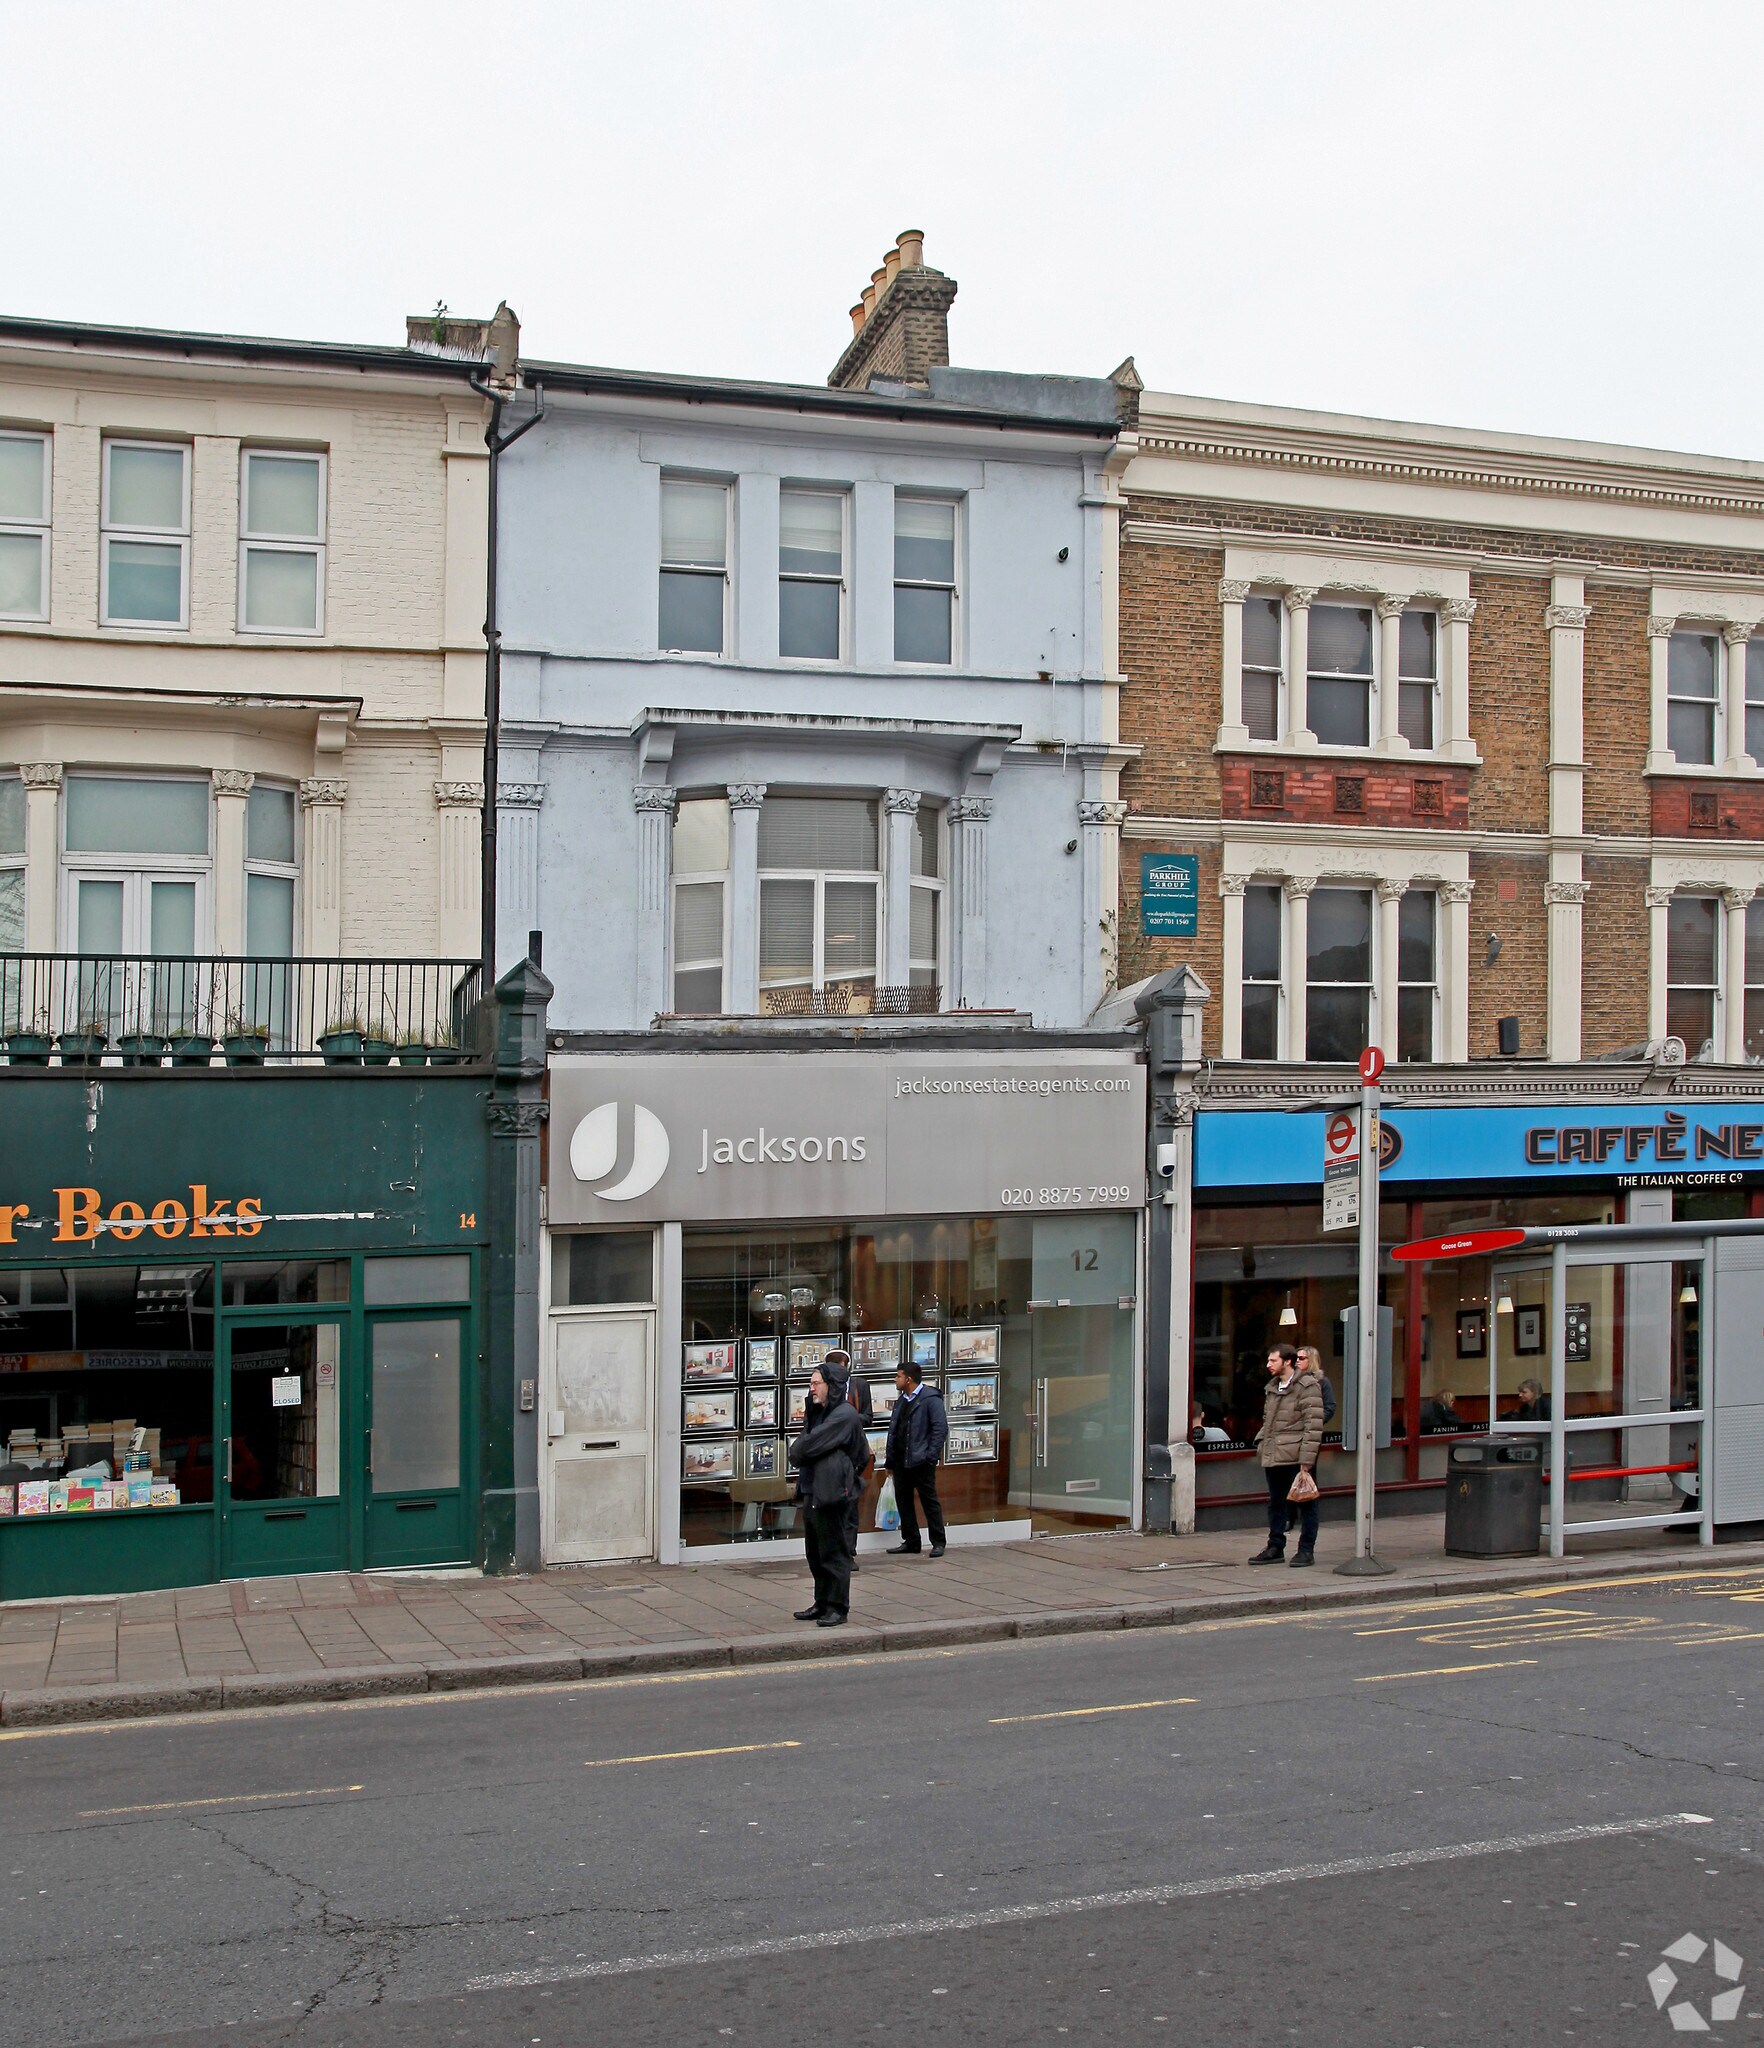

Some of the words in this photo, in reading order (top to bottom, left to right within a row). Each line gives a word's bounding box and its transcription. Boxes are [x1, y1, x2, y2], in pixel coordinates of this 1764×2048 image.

[1149, 872, 1190, 881] PARKHILL
[1364, 1051, 1376, 1077] J
[894, 1076, 1131, 1098] jacksonsestateagents.com
[1525, 1110, 1688, 1164] CAFFÈ
[697, 1127, 867, 1174] Jacksons
[1617, 1175, 1638, 1187] THE
[1640, 1174, 1684, 1186] ITALIAN
[1686, 1173, 1726, 1185] COFFEE
[1001, 1188, 1033, 1205] 020
[1039, 1187, 1082, 1204] 8875
[1088, 1186, 1130, 1202] 7999
[52, 1185, 263, 1241] Books
[459, 1213, 476, 1229] 14
[1547, 1229, 1562, 1237] 0128
[1457, 1240, 1473, 1248] Green
[1070, 1248, 1099, 1272] 12
[273, 1397, 300, 1405] CLOSED
[1433, 1425, 1459, 1433] PANINI
[1207, 1441, 1245, 1451] ESPRESSO
